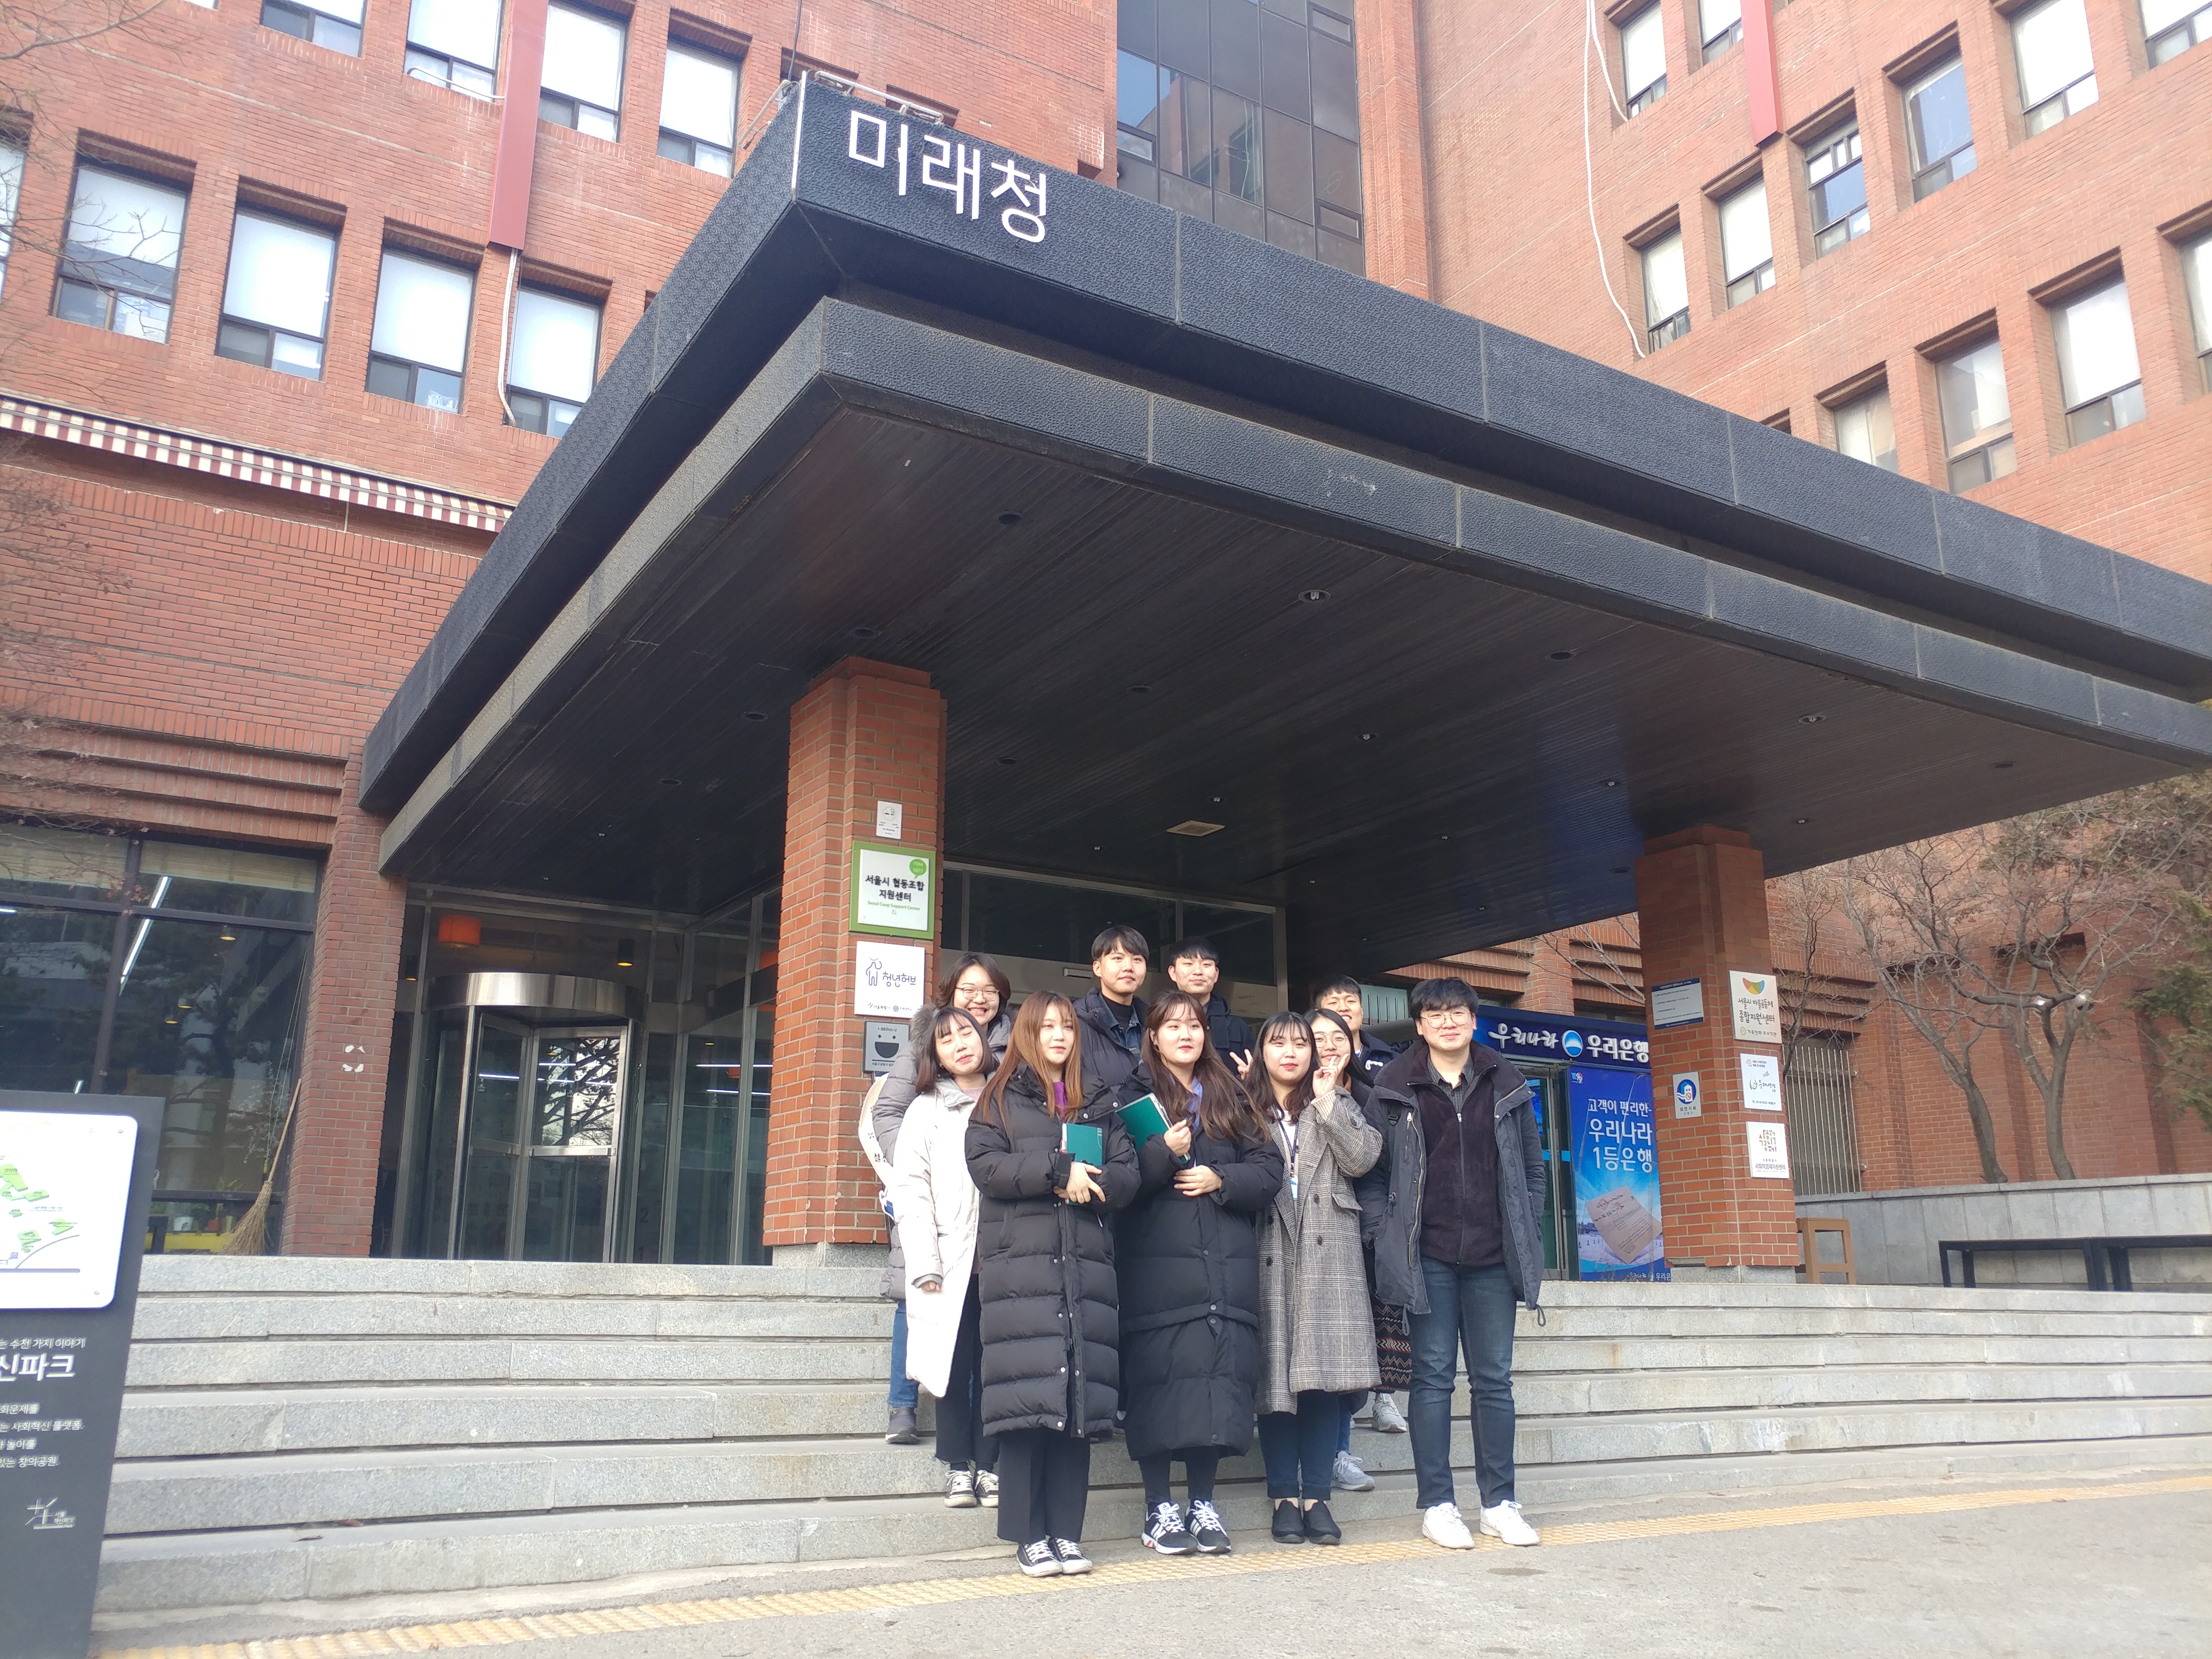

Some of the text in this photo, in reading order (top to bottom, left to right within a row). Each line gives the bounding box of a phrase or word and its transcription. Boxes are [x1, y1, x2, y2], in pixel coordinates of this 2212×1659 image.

[849, 110, 1048, 243] 미래청
[865, 875, 925, 891] 서울시 협동조합
[879, 889, 911, 902] 지원센터
[883, 971, 916, 987] 청년허브
[1738, 998, 1773, 1010] 서울시 마을공동체
[1739, 1010, 1775, 1025] 종합지원센터
[1487, 1023, 1649, 1063] 우리나라 우리은행
[1588, 1098, 1617, 1115] 고객이
[1588, 1118, 1653, 1146] 우리나라
[1593, 1146, 1653, 1173] 1등은행
[9, 1339, 30, 1350] 수천
[32, 1338, 53, 1349] 가지
[55, 1337, 85, 1349] 이야기
[0, 1354, 75, 1382] 신파크
[11, 1421, 50, 1432] 사회혁신
[6, 1439, 36, 1450] 놀이를
